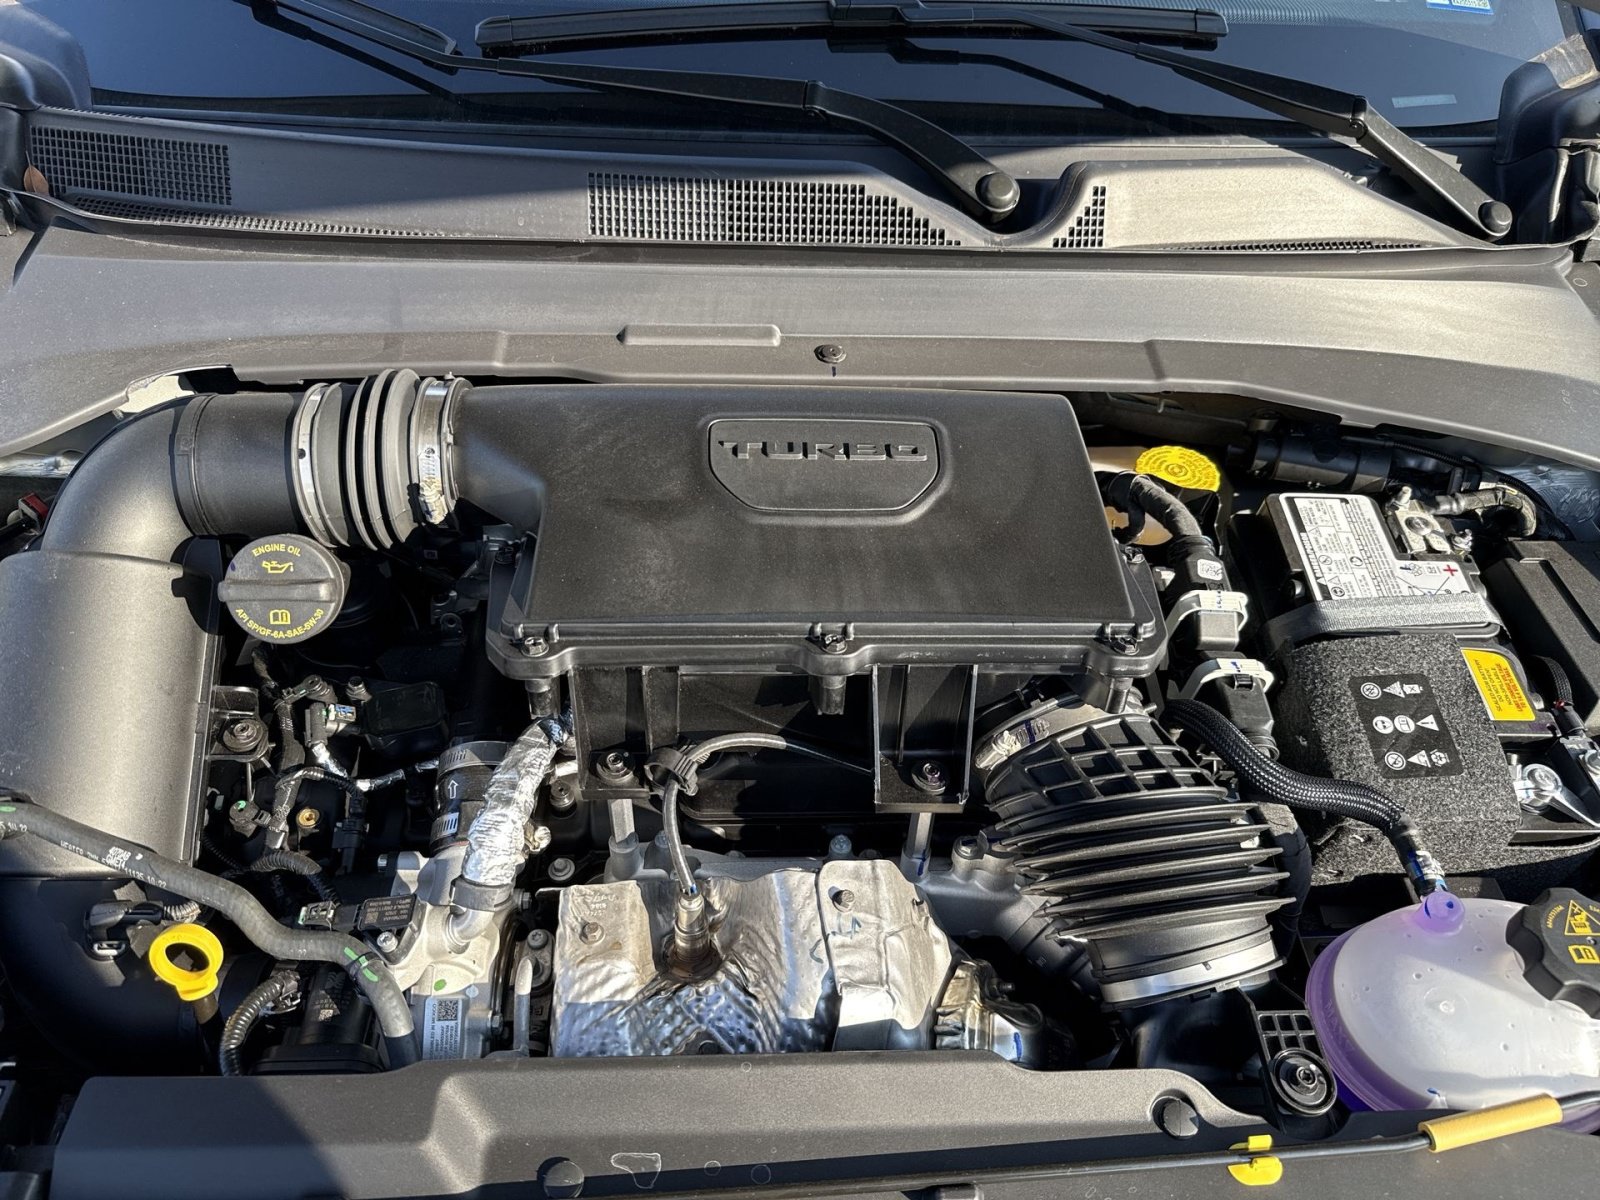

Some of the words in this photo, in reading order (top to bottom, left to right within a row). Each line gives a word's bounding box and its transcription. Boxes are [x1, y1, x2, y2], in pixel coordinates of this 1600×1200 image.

[718, 440, 927, 461] TURBO
[251, 543, 286, 557] ENGINE
[287, 544, 302, 557] OIL
[235, 608, 248, 624] API
[1475, 660, 1487, 680] BATTERY
[1490, 692, 1502, 711] SEALED
